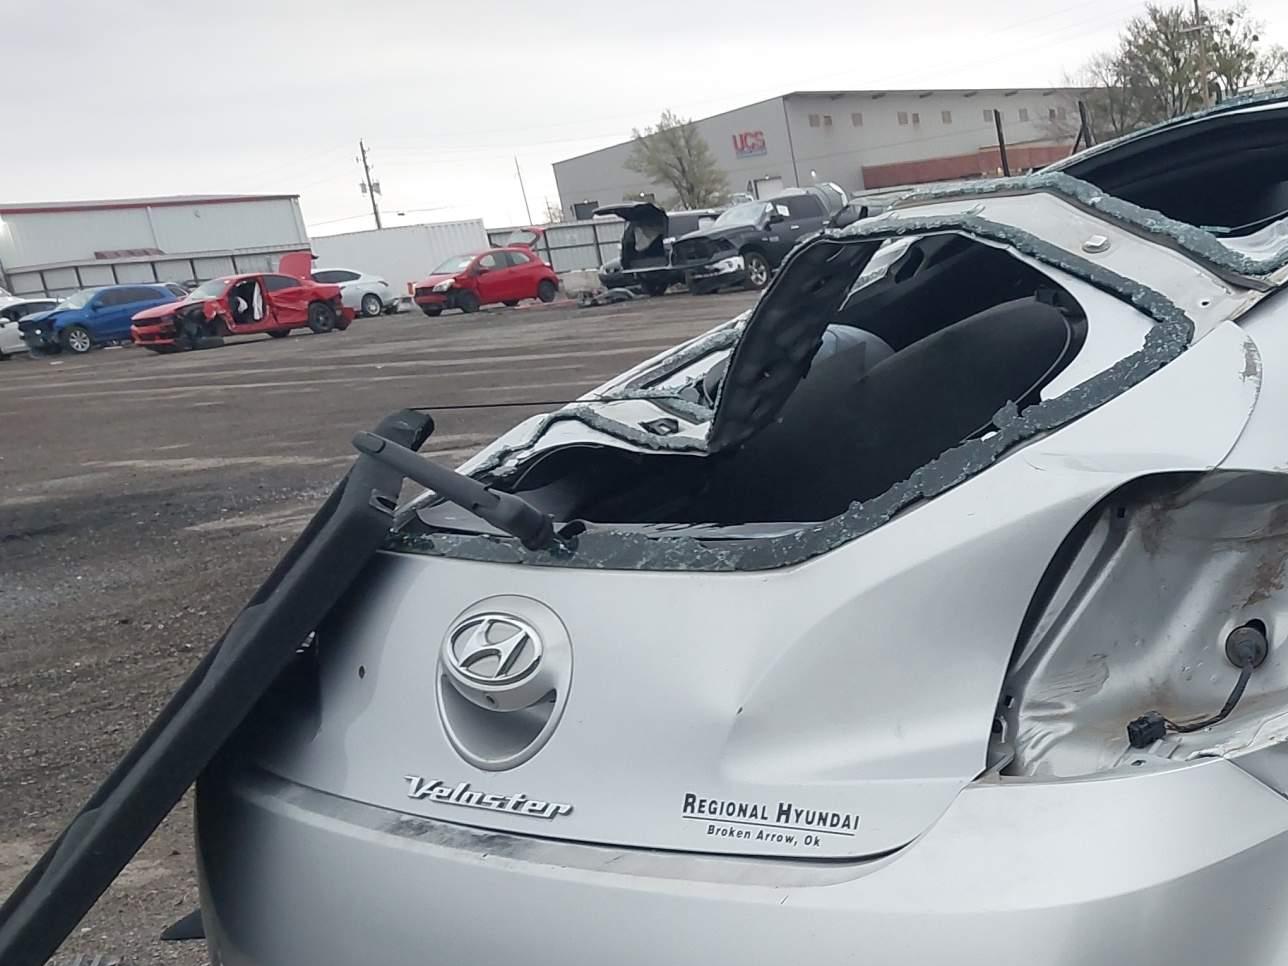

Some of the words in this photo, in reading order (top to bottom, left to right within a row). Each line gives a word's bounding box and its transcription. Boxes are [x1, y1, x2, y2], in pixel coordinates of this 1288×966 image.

[732, 130, 766, 151] UCS
[707, 825, 750, 839] Broken
[756, 830, 798, 846] Arrow,
[804, 835, 820, 846] Ok
